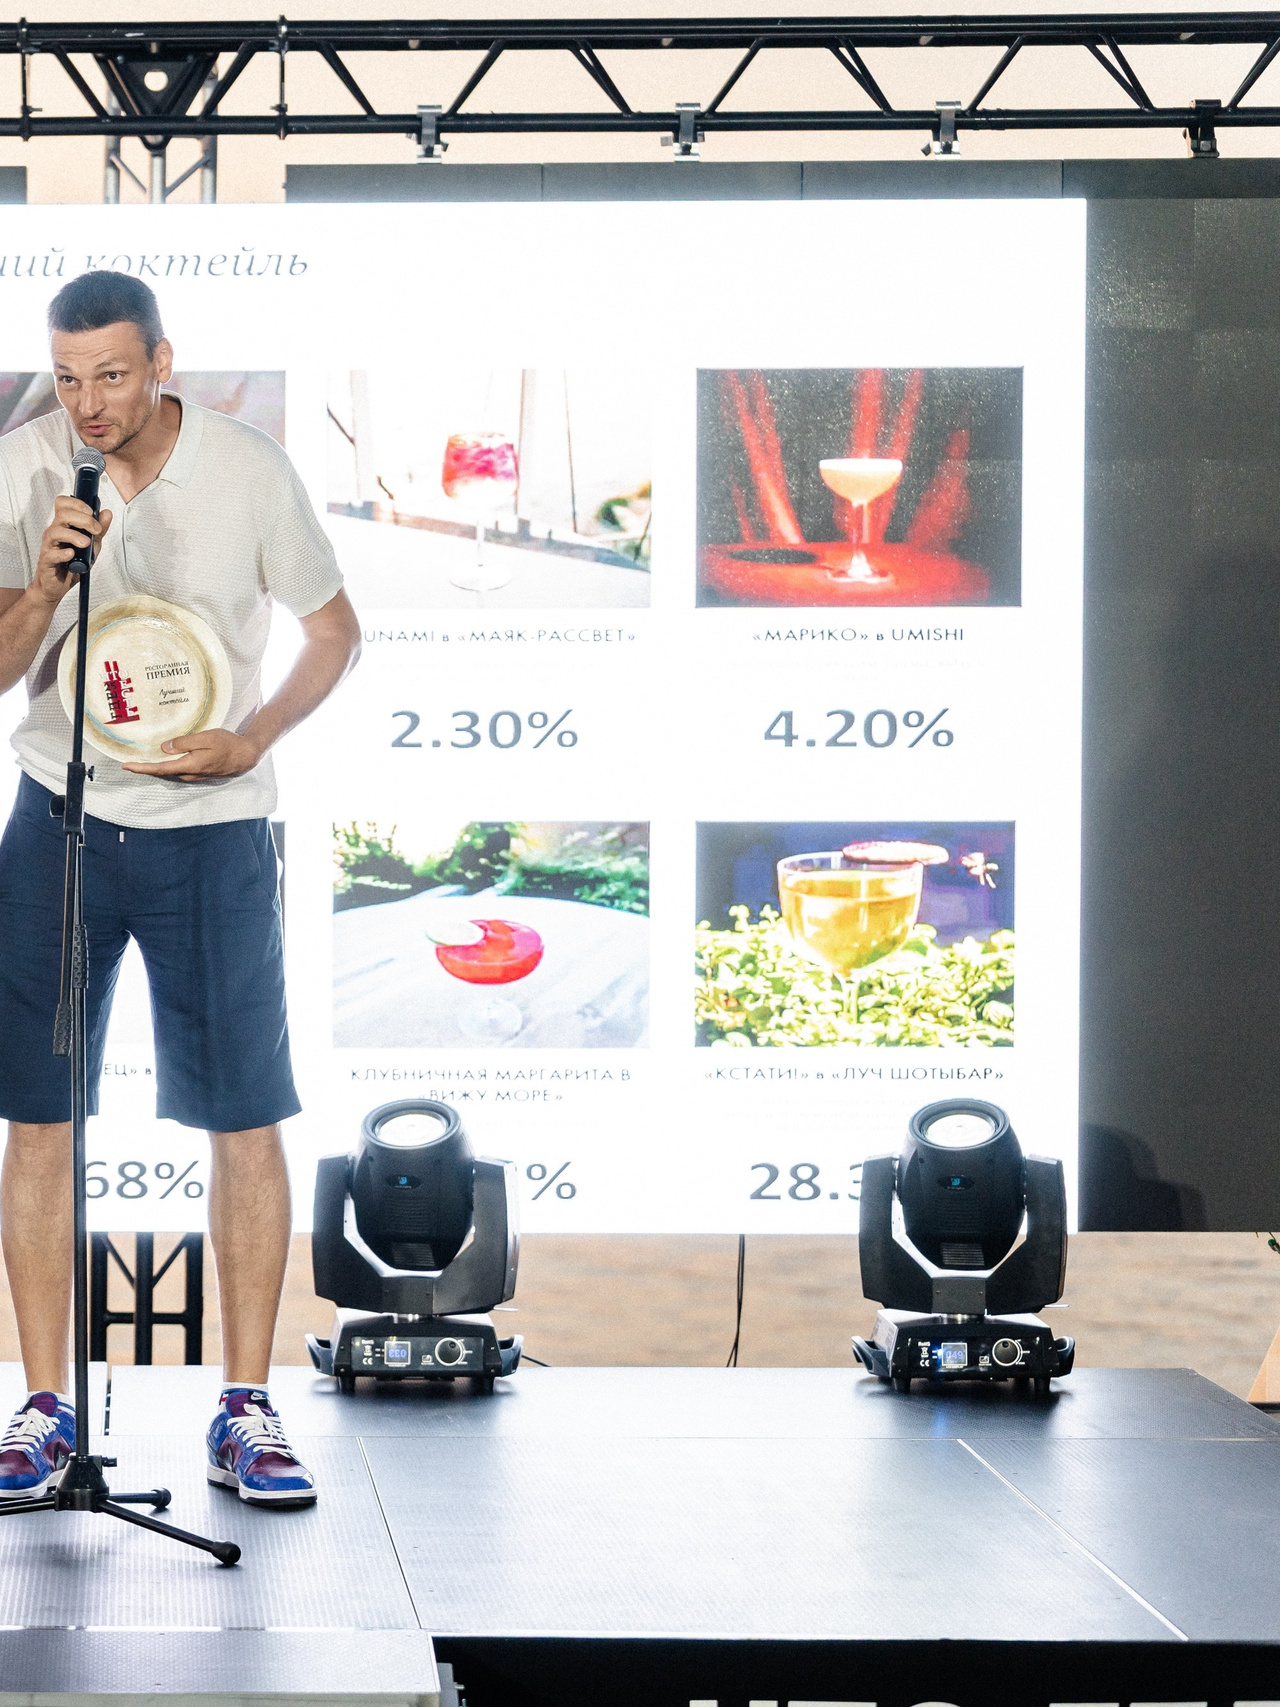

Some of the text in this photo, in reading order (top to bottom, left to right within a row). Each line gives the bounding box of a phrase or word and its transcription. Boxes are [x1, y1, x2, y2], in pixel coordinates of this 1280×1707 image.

[85, 246, 309, 277] коктейль
[442, 634, 450, 642] в
[458, 629, 636, 642] «МАЯК-РАССВЕТ»
[753, 628, 964, 641] «МАРИКО» в UMISHI
[145, 661, 189, 672] РЕСТОРАННАЯ
[146, 666, 191, 680] ПРЕМИЯ
[390, 709, 578, 749] 2.30%
[764, 707, 954, 748] 4.20%
[351, 1068, 486, 1081] КЛУБНИЧНАЯ
[495, 1068, 613, 1081] МАРГАРИТА
[704, 1067, 809, 1080] «КСТАТИ!»
[816, 1071, 824, 1079] в
[495, 1089, 563, 1101] МОРЕ»
